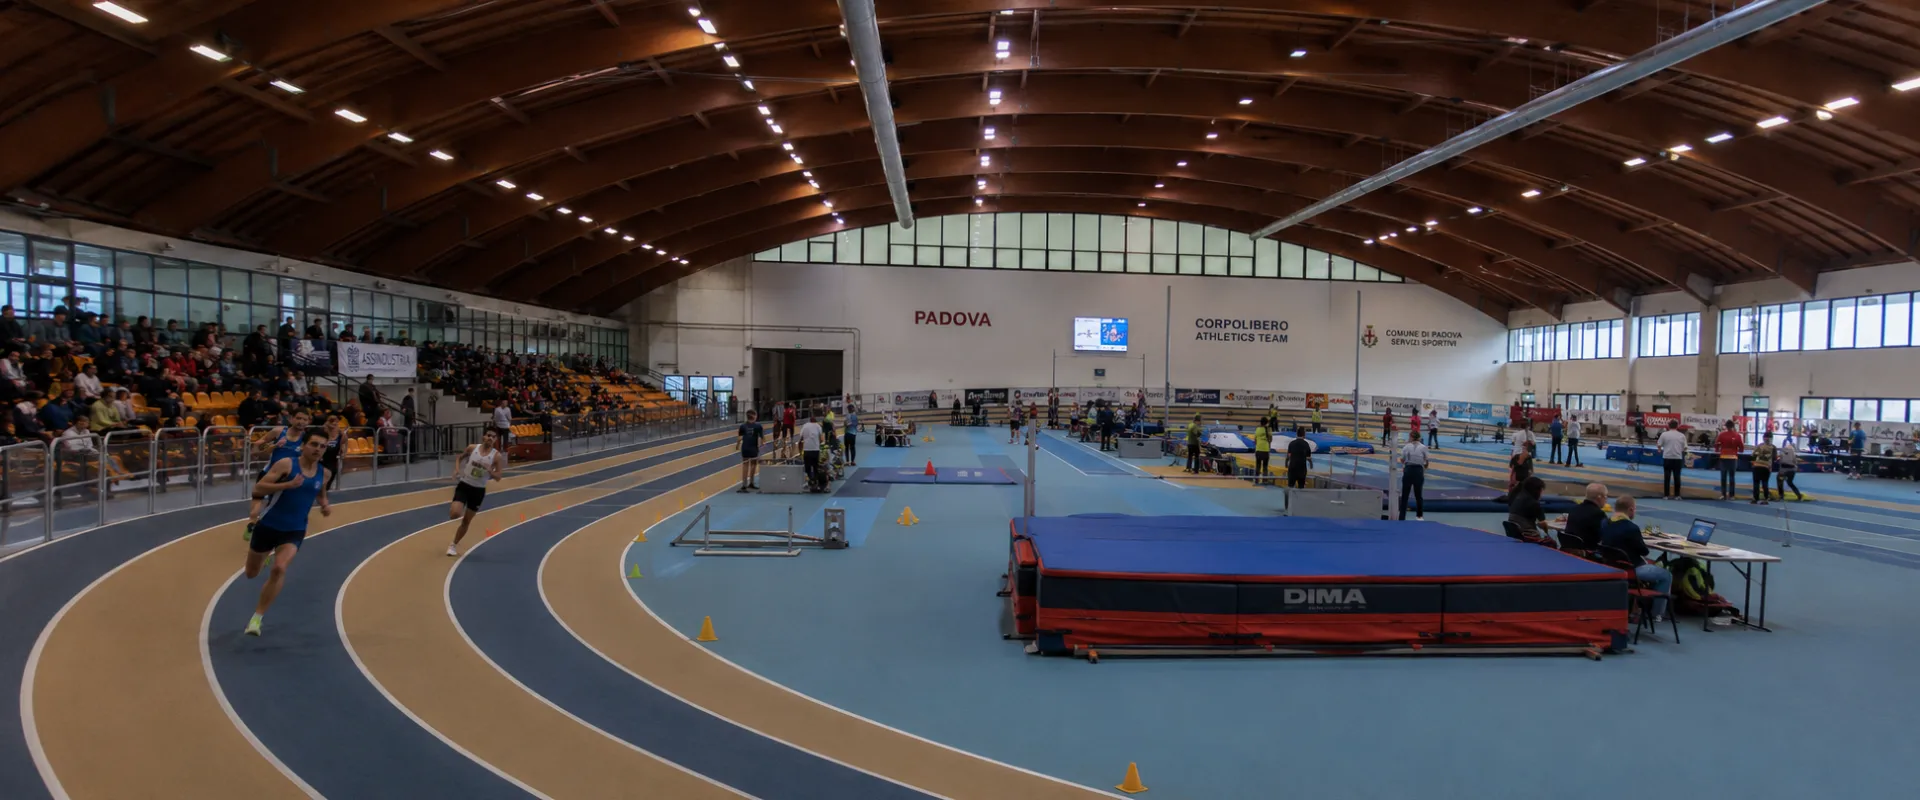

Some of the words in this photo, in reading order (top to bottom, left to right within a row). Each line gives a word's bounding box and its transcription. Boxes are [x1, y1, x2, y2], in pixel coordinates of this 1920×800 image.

[914, 310, 992, 328] PADOVA
[1195, 318, 1289, 331] CORPOLIBERO
[1195, 332, 1255, 342] ATHLETICS
[1258, 333, 1288, 343] TEAM
[1385, 329, 1419, 338] COMUNE
[1421, 330, 1430, 338] DI
[1431, 331, 1462, 339] PADOVA
[1391, 338, 1420, 346] SERVIZI
[1421, 339, 1457, 347] SPORTIVI
[362, 352, 411, 366] ASSINDUSTRIA
[1283, 588, 1367, 604] DIMA
